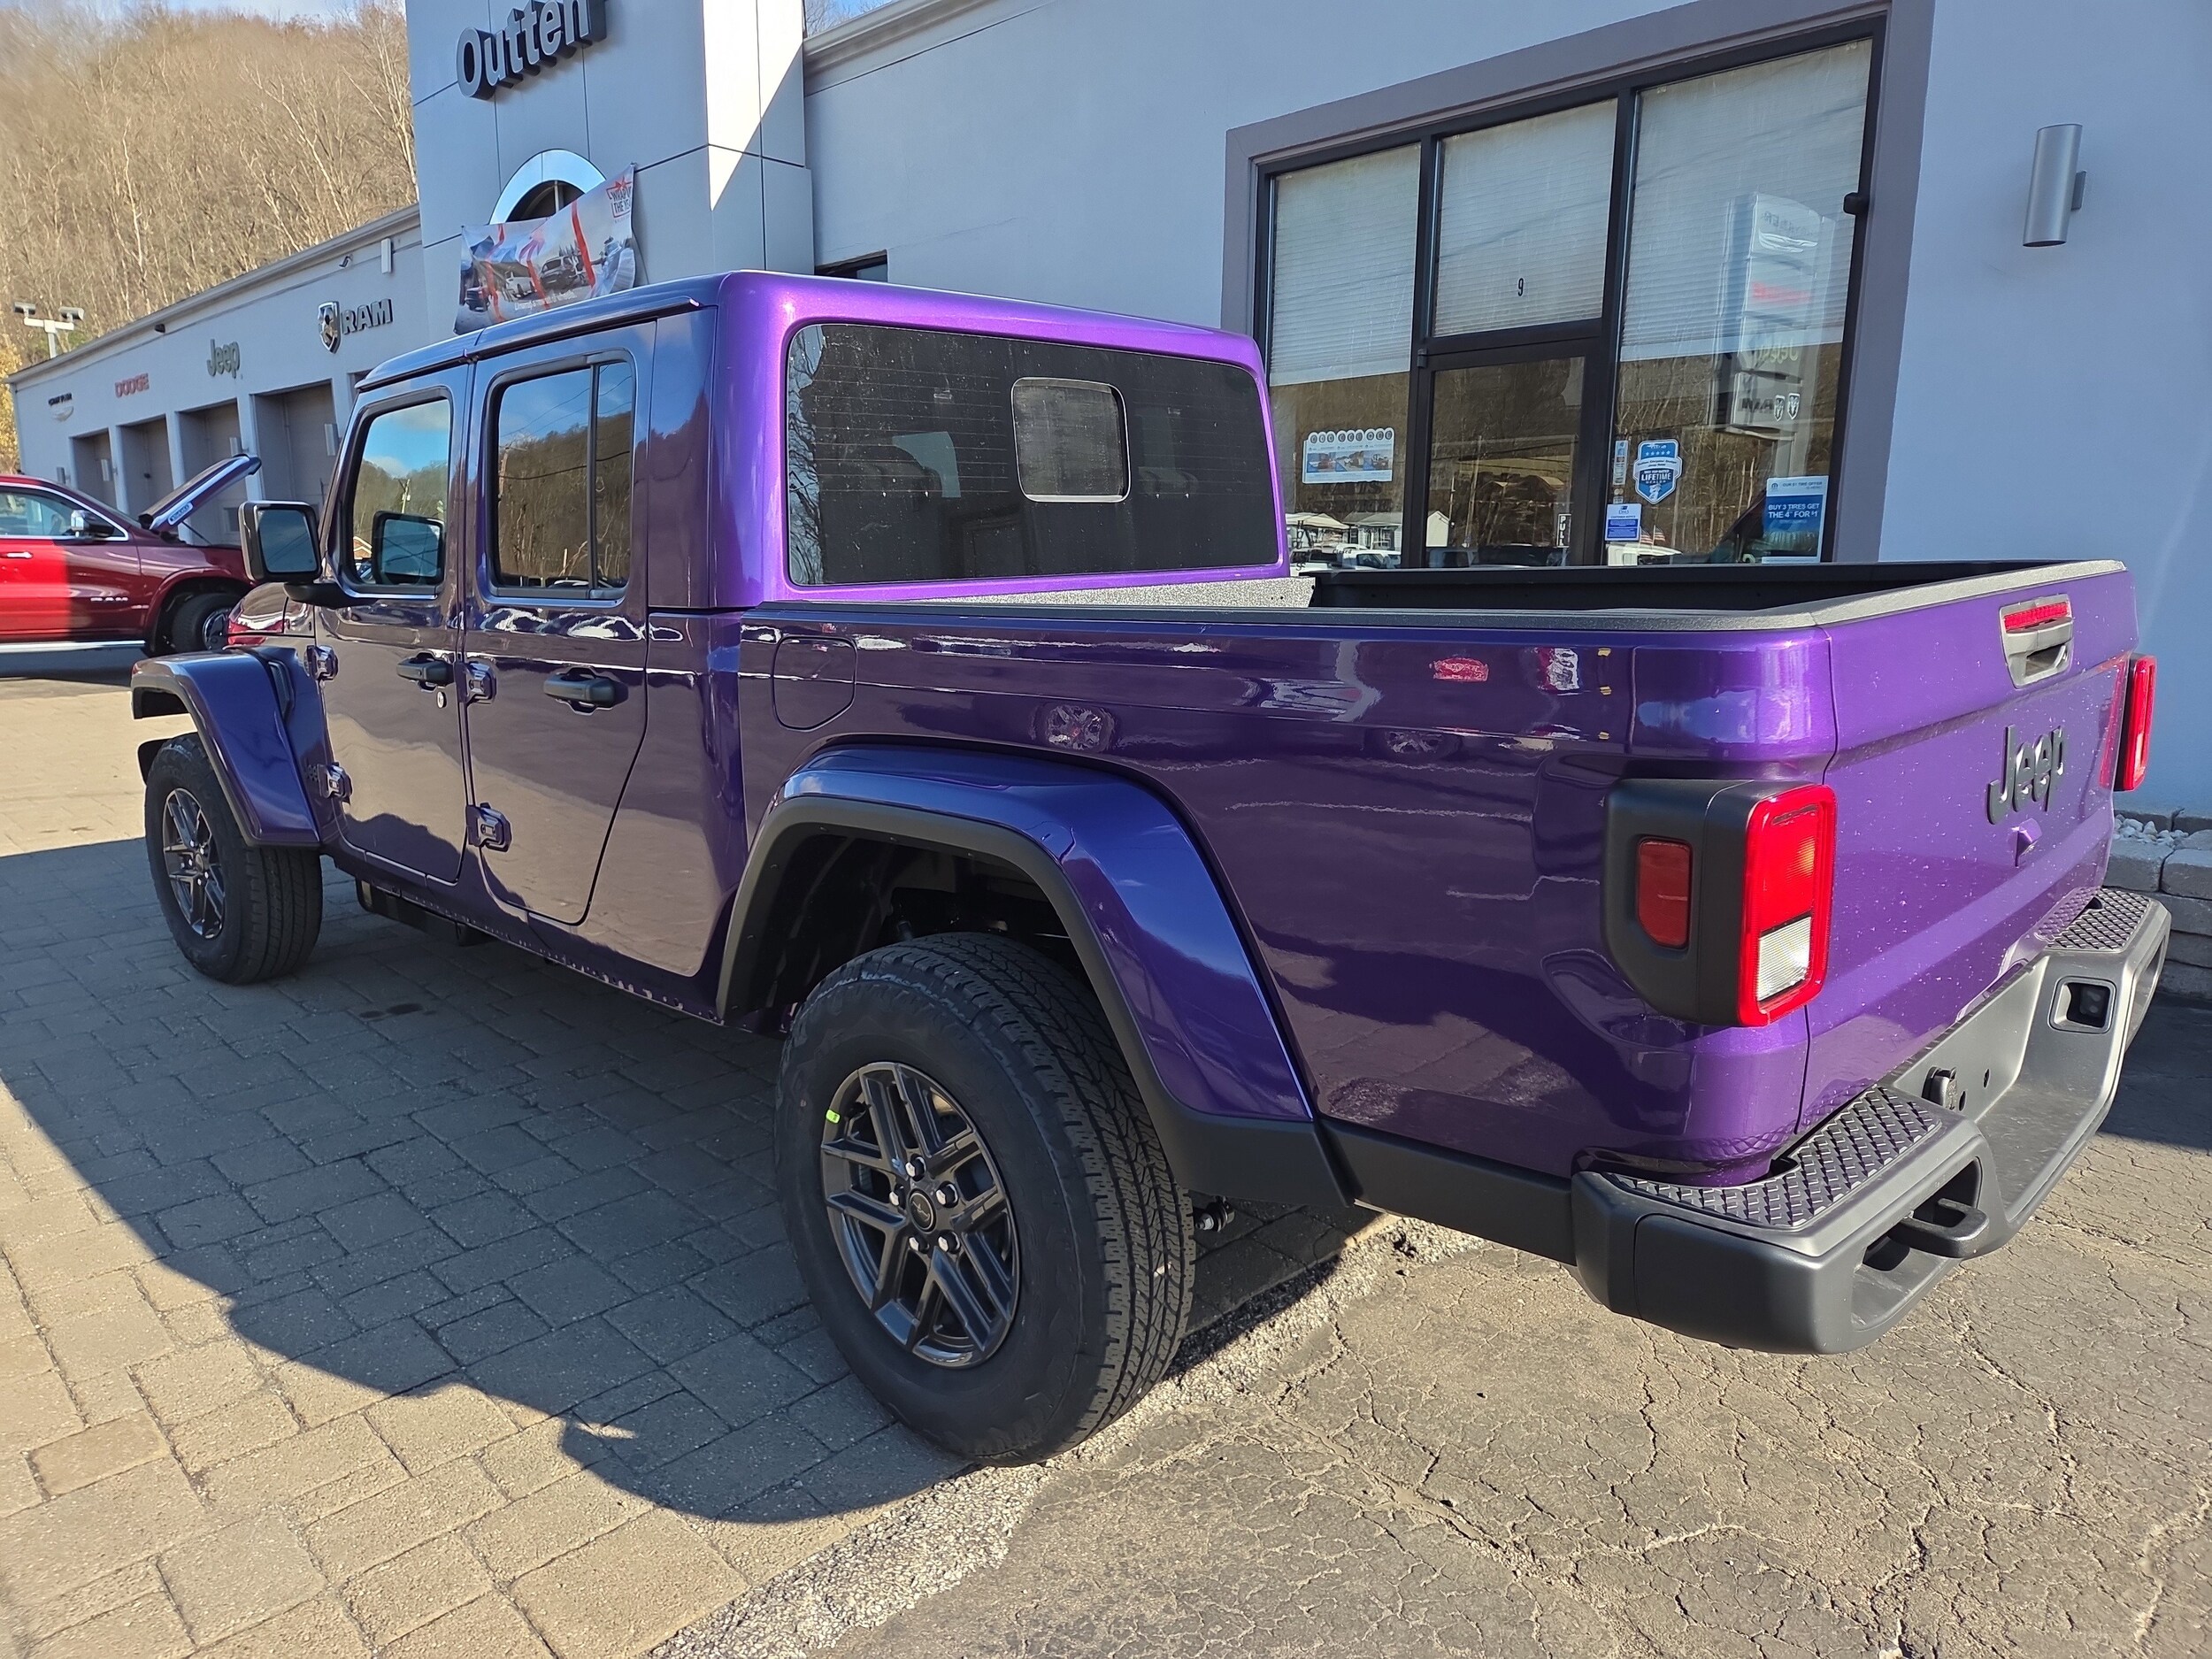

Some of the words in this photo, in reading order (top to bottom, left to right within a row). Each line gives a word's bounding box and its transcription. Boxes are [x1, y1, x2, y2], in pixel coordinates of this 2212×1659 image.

[457, 0, 598, 99] Outten
[1517, 278, 1524, 296] 9
[342, 299, 393, 335] RAM
[207, 339, 240, 378] Jeep
[115, 373, 150, 398] DODGE
[1641, 472, 1672, 481] LIFETIME
[1987, 725, 2064, 825] Jeep
